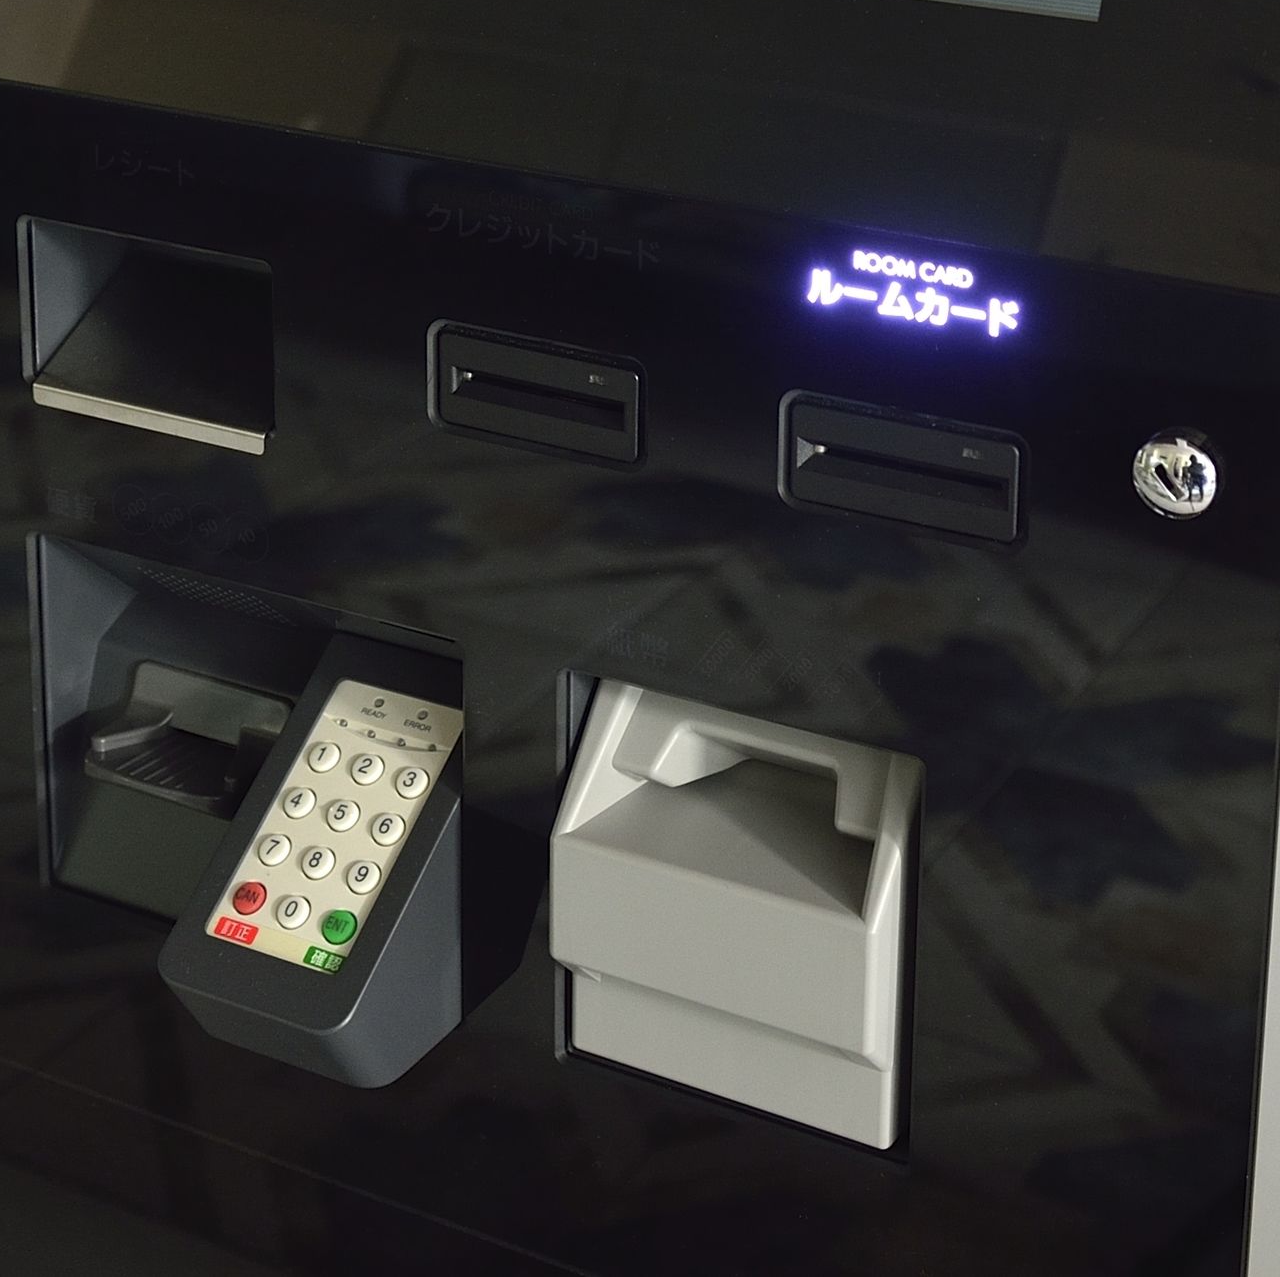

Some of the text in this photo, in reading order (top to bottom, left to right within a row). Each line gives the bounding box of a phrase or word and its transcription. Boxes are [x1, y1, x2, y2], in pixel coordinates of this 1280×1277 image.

[425, 202, 662, 271] クレジットカード
[852, 250, 974, 288] ROOM CARD
[807, 268, 1019, 337] ルームカード
[361, 707, 386, 720] READY
[403, 719, 432, 733] ERROR
[317, 747, 417, 788] 1 2 3
[290, 793, 393, 834] 4 5 6
[267, 839, 369, 883] 7 8 9
[235, 887, 259, 904] CAN
[284, 900, 298, 918] 0
[325, 916, 350, 934] ENT
